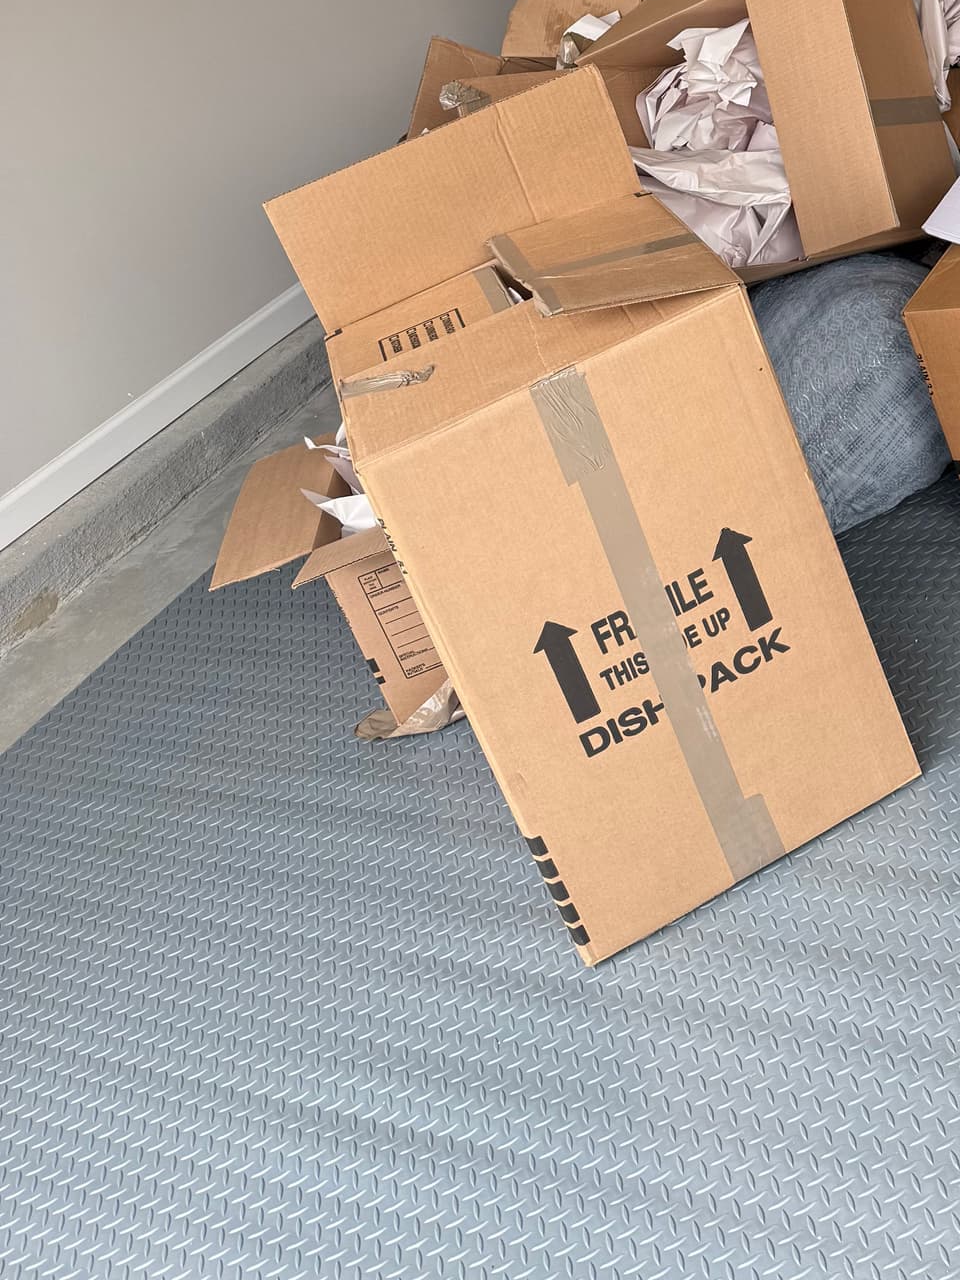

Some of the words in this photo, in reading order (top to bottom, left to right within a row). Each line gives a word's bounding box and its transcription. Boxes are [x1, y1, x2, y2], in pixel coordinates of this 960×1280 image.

[590, 567, 715, 654] FRILE
[599, 651, 649, 691] THIS
[702, 606, 731, 638] UP
[578, 695, 665, 757] DISH
